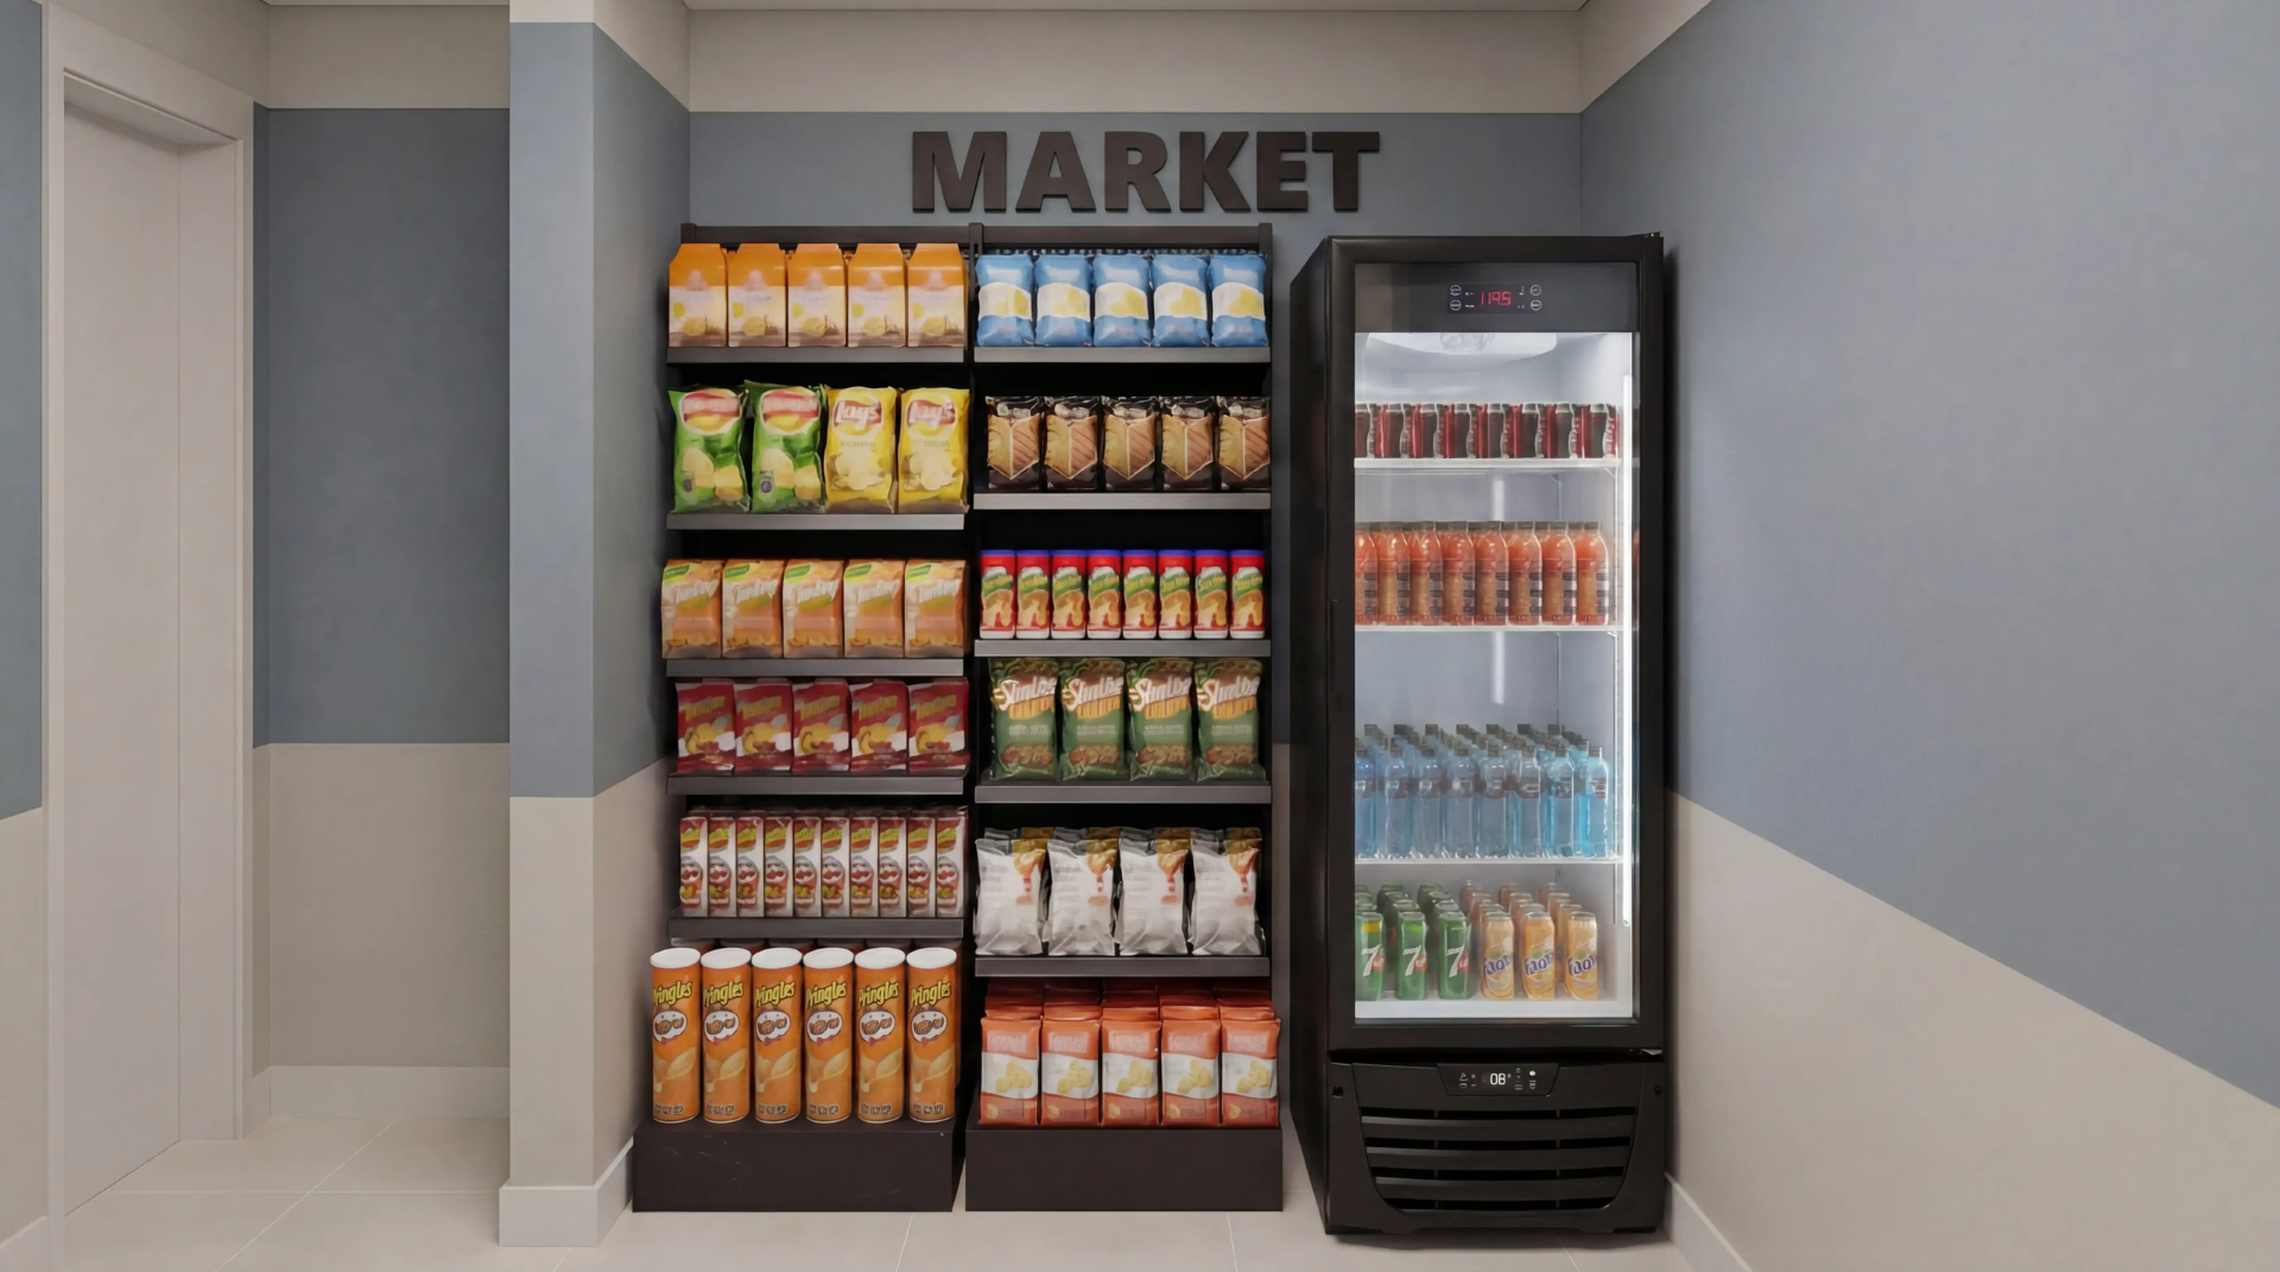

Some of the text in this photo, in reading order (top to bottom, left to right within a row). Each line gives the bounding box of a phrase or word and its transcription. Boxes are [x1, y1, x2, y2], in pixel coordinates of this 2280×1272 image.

[912, 131, 1380, 213] MARKET
[755, 980, 795, 1008] Pringles
[806, 980, 847, 1007] Pringles
[858, 980, 899, 1007] Pringles
[910, 979, 951, 1007] Pringles
